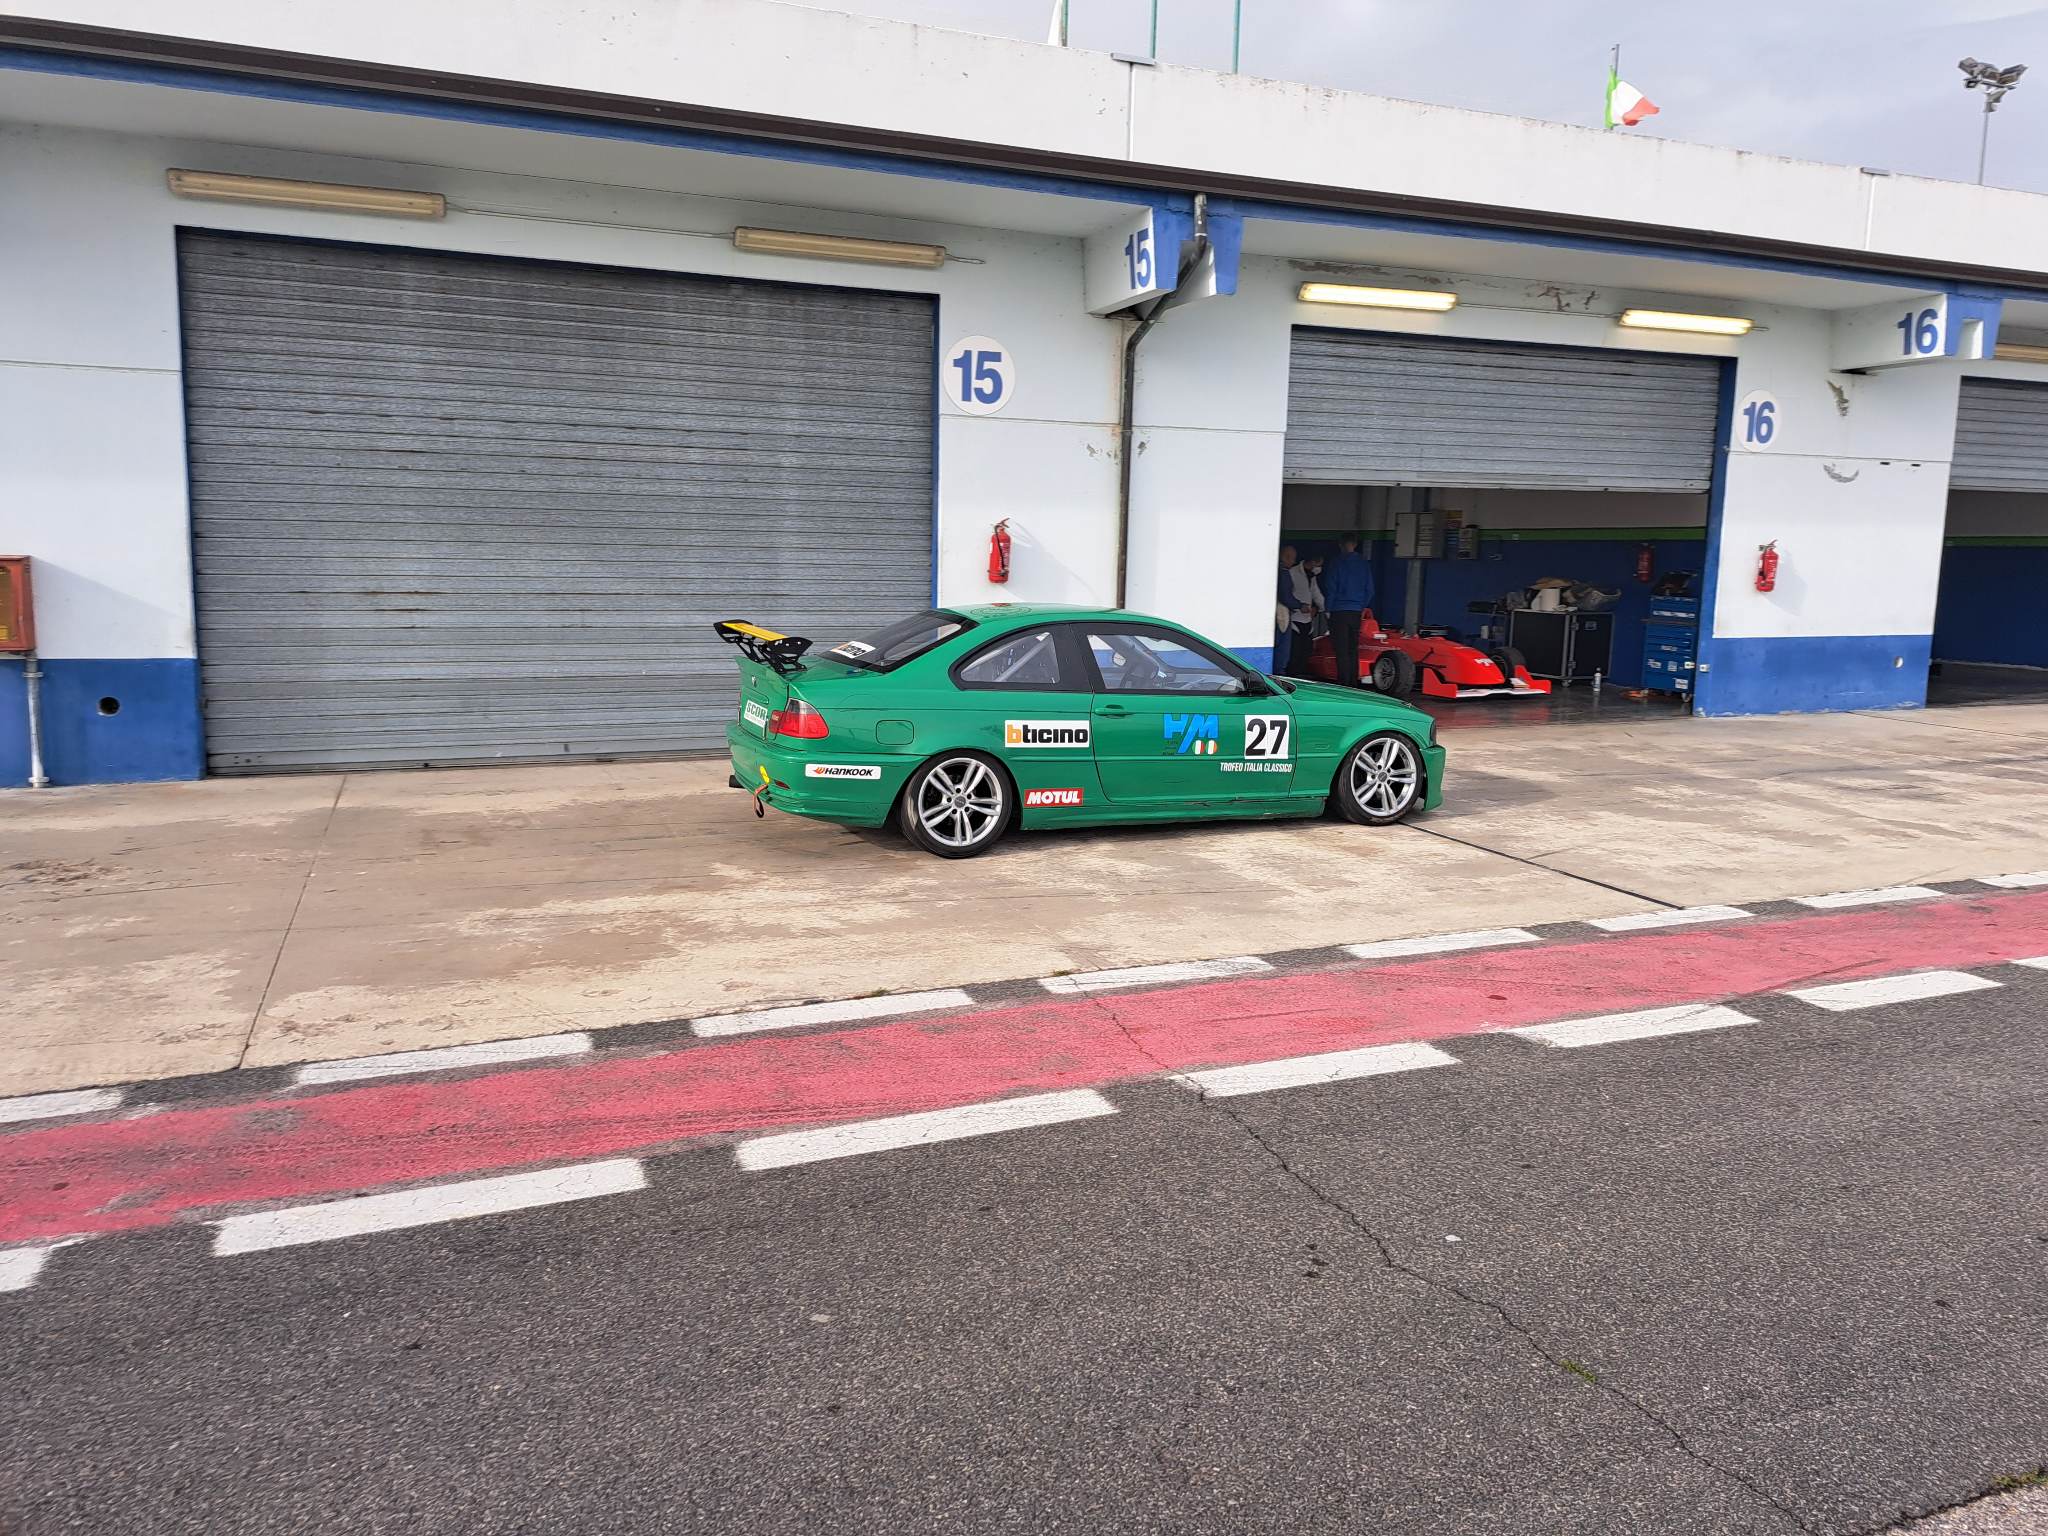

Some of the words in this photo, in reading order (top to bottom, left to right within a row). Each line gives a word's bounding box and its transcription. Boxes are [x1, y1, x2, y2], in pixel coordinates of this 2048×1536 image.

[1125, 228, 1152, 290] 15
[1897, 308, 1940, 356] 16
[952, 349, 1004, 405] 15
[1743, 401, 1775, 444] 16
[1006, 724, 1089, 743] bticino
[1245, 718, 1288, 756] 27
[1220, 762, 1243, 772] TROFEO
[1243, 763, 1263, 772] ITALIA
[1263, 763, 1293, 773] CLASSICO
[1026, 791, 1080, 805] MOTUL
